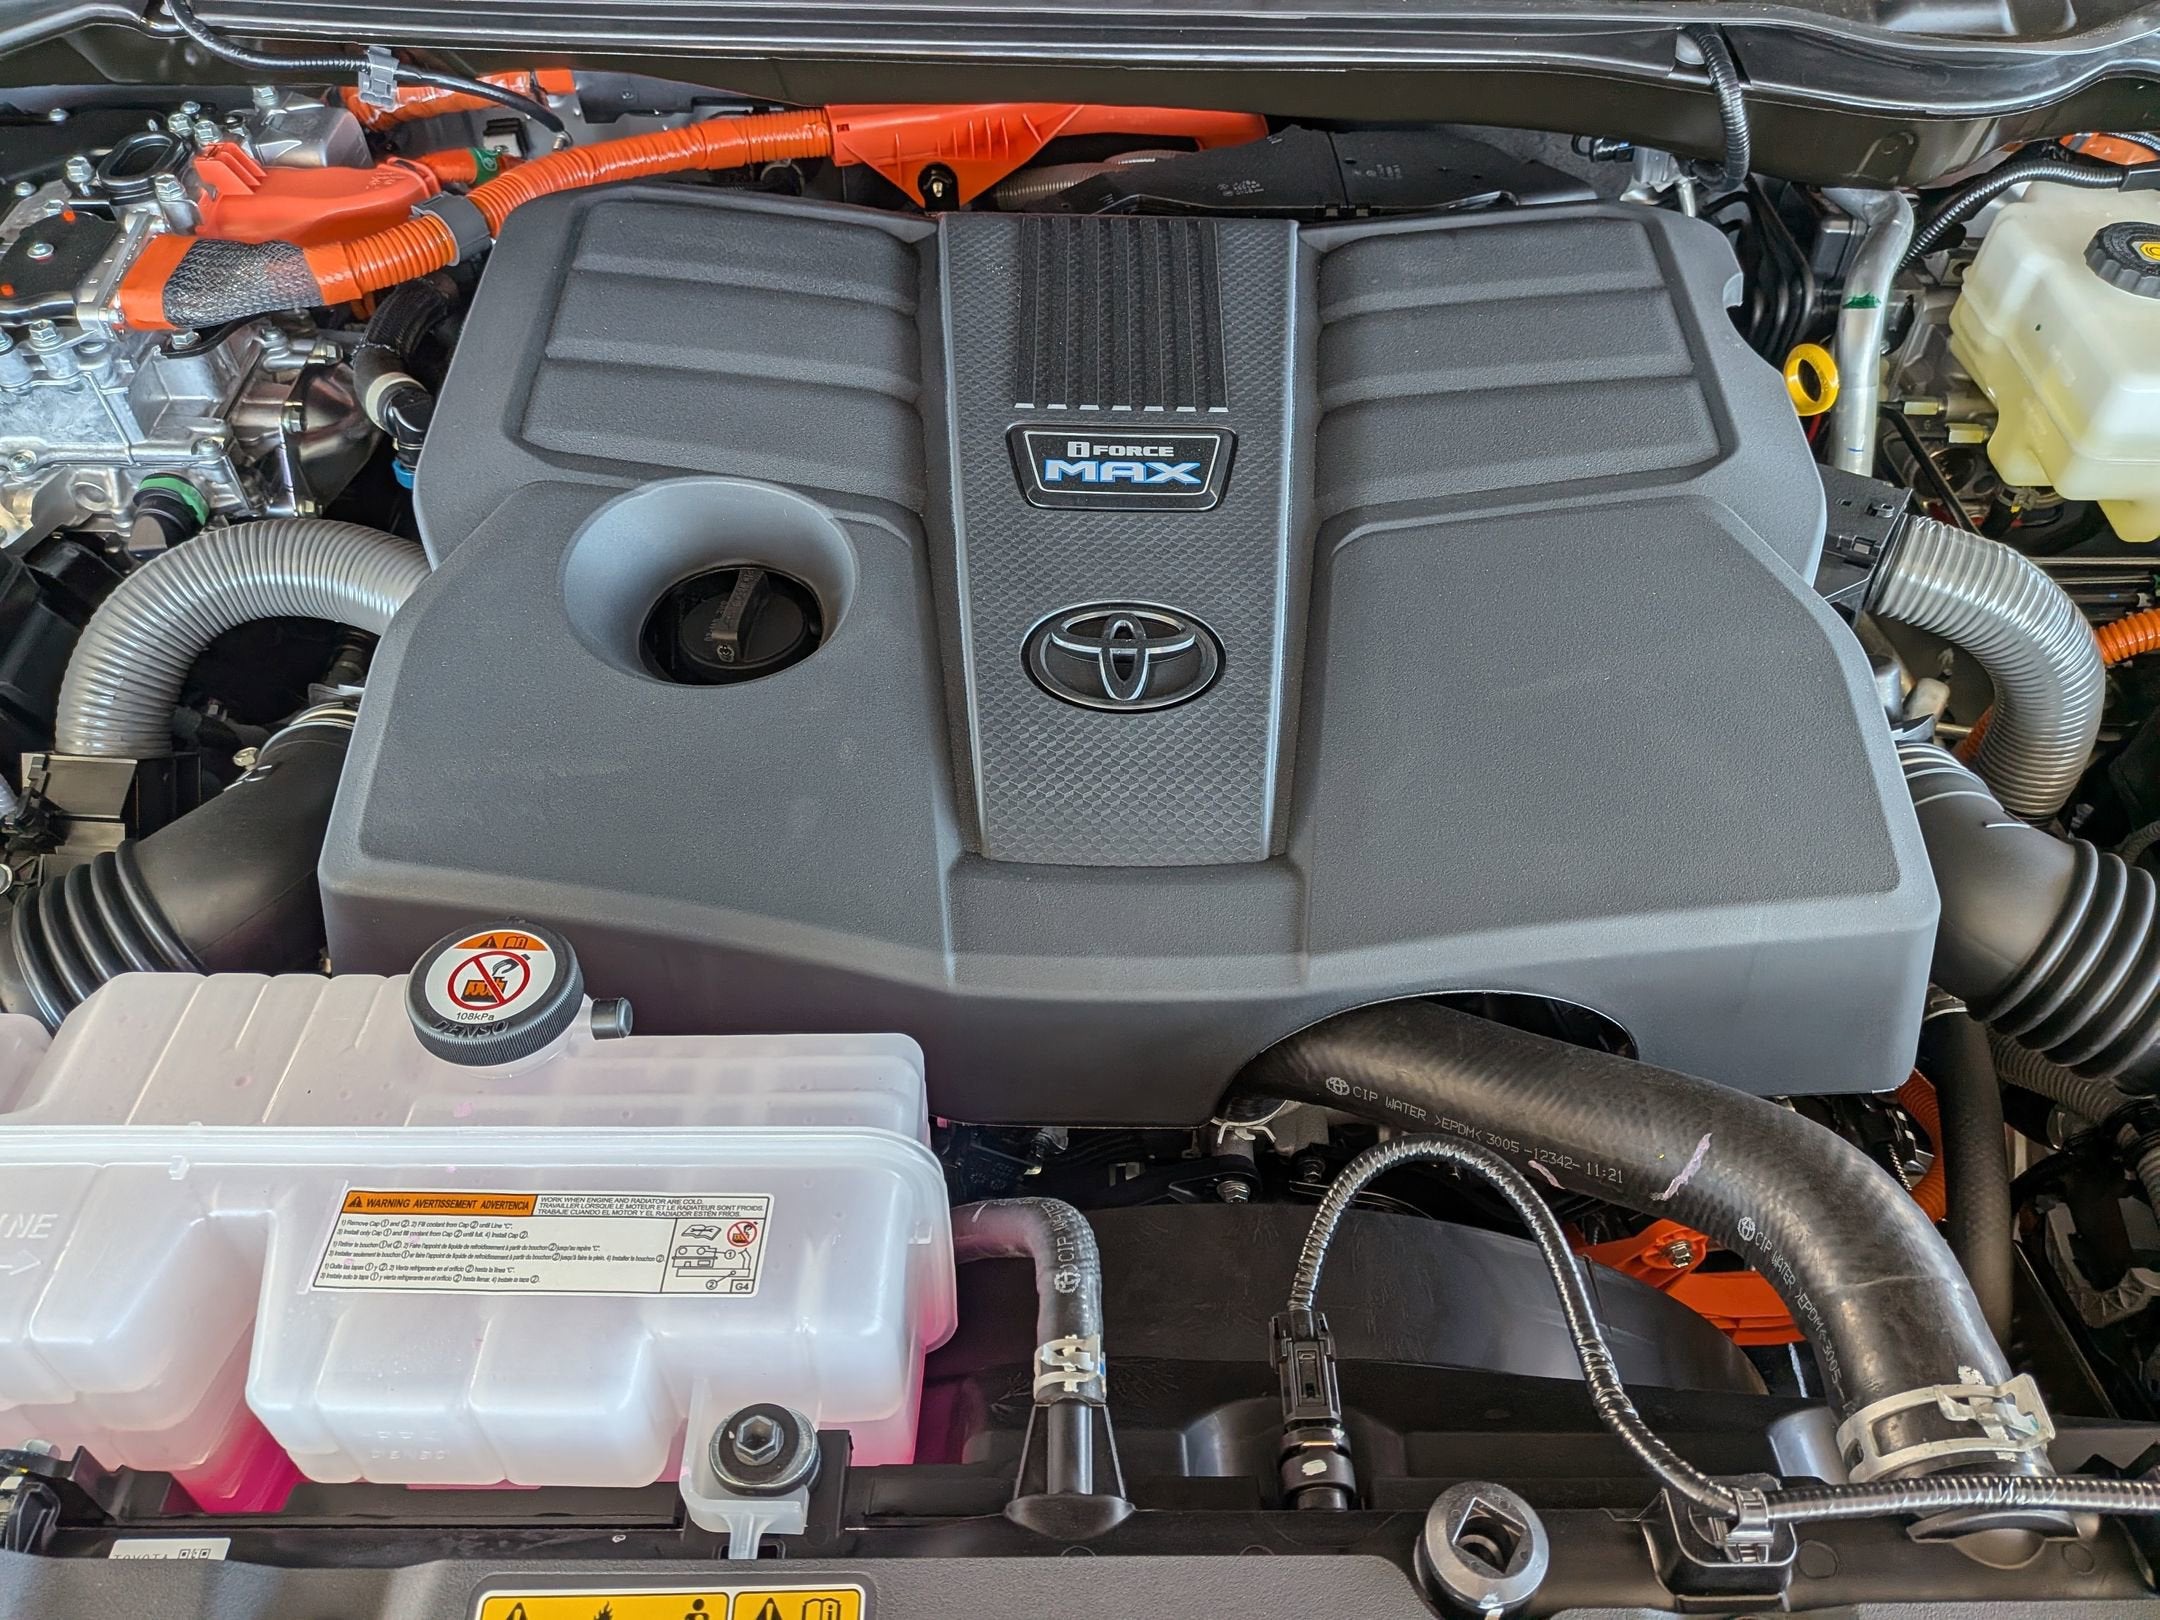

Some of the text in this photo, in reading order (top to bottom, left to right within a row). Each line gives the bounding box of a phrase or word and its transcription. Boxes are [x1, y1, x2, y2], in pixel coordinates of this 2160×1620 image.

[1044, 459, 1202, 484] MAX
[455, 1012, 496, 1021] 108kPa
[431, 1020, 512, 1038] DENSO
[1353, 1086, 1378, 1102] CIP
[1385, 1096, 1427, 1121] WATER
[1486, 1132, 1520, 1154] 3005
[1586, 1161, 1623, 1184] 11:21
[366, 1198, 529, 1211] WARNING AVERTISSEMENT ADVERTENCIA
[538, 1208, 570, 1216] TRABAJE
[1056, 1236, 1075, 1262] CIP
[1754, 1232, 1772, 1253] CIP
[1772, 1249, 1796, 1290] WATER
[736, 1282, 749, 1290] G4
